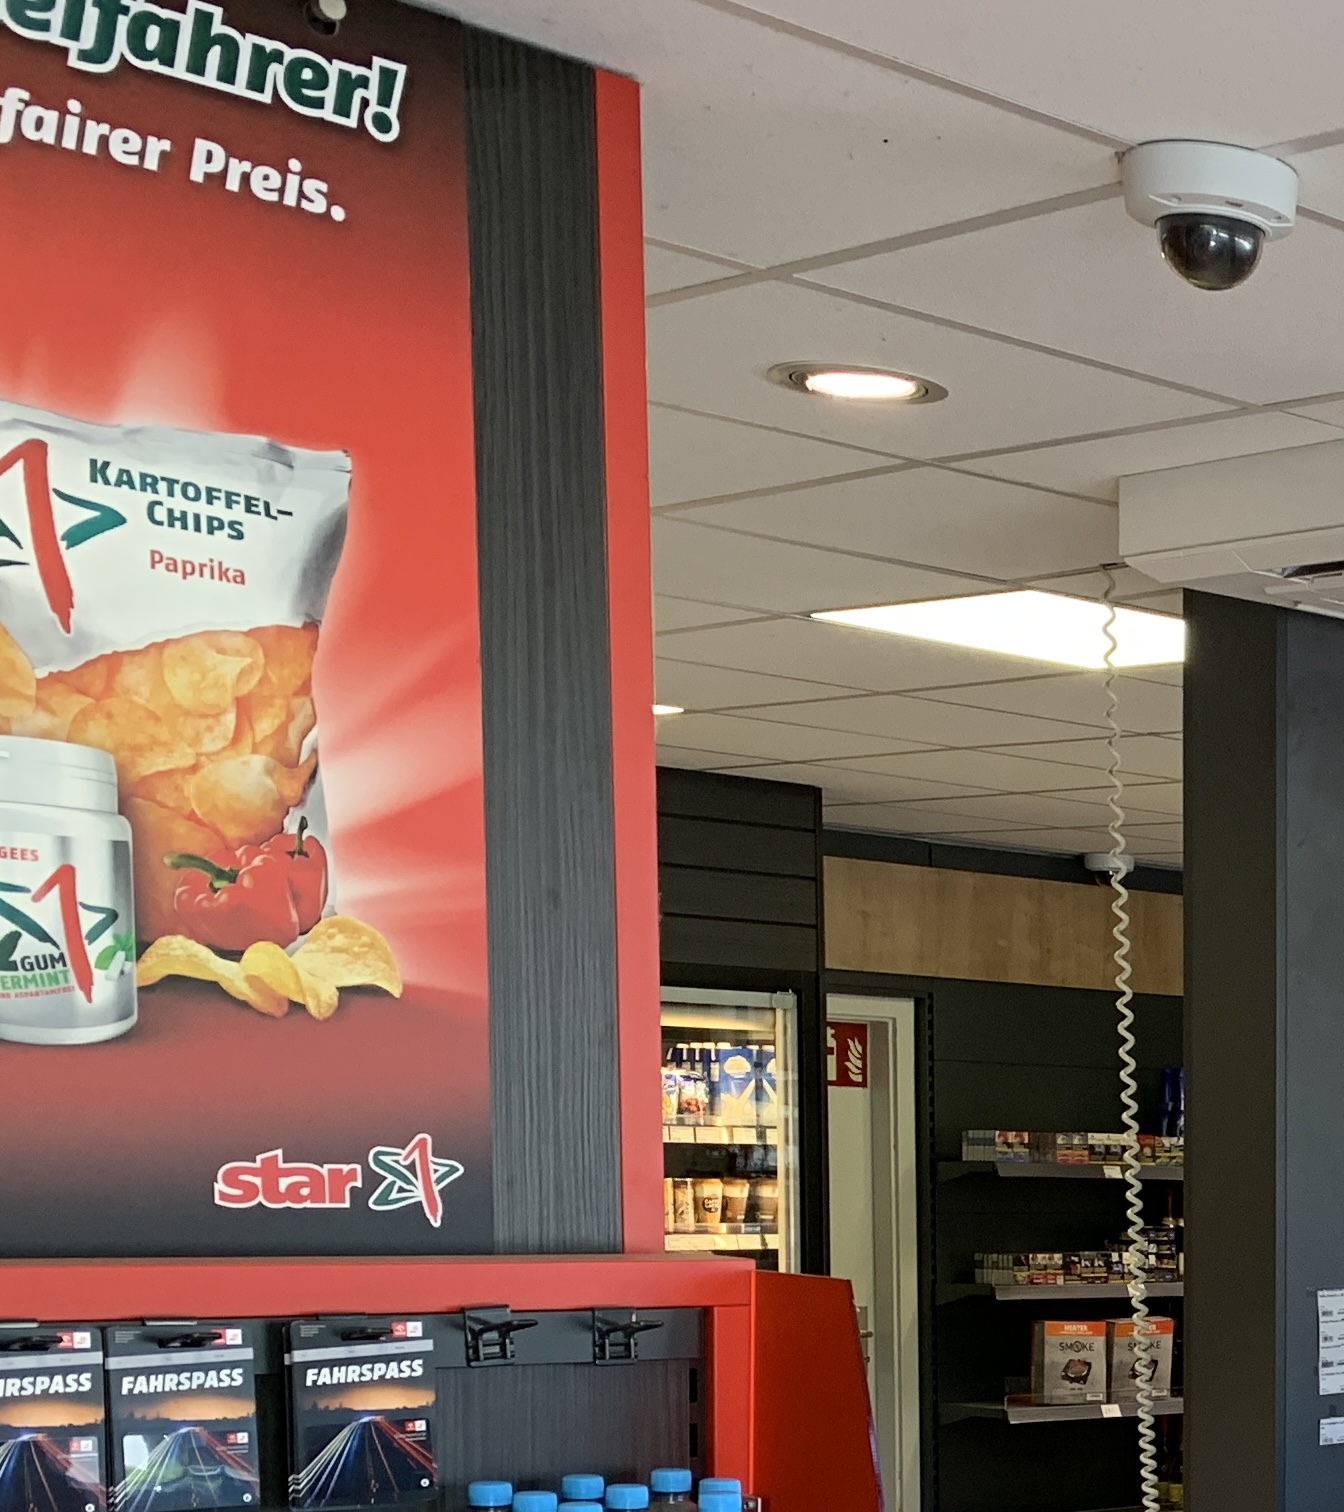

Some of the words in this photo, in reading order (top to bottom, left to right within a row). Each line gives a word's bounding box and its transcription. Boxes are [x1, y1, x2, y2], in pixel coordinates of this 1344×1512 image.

[0, 87, 171, 170] fairer
[190, 138, 347, 222] Preis.
[89, 458, 293, 520] KARTOFFEL-
[146, 500, 245, 540] CHIPS
[150, 549, 247, 586] Paprika
[0, 969, 70, 990] ERMINT
[20, 951, 67, 972] GUM
[215, 1149, 361, 1208] star
[121, 1367, 244, 1395] FAHRSPASS
[305, 1358, 424, 1388] FAHRSPASS
